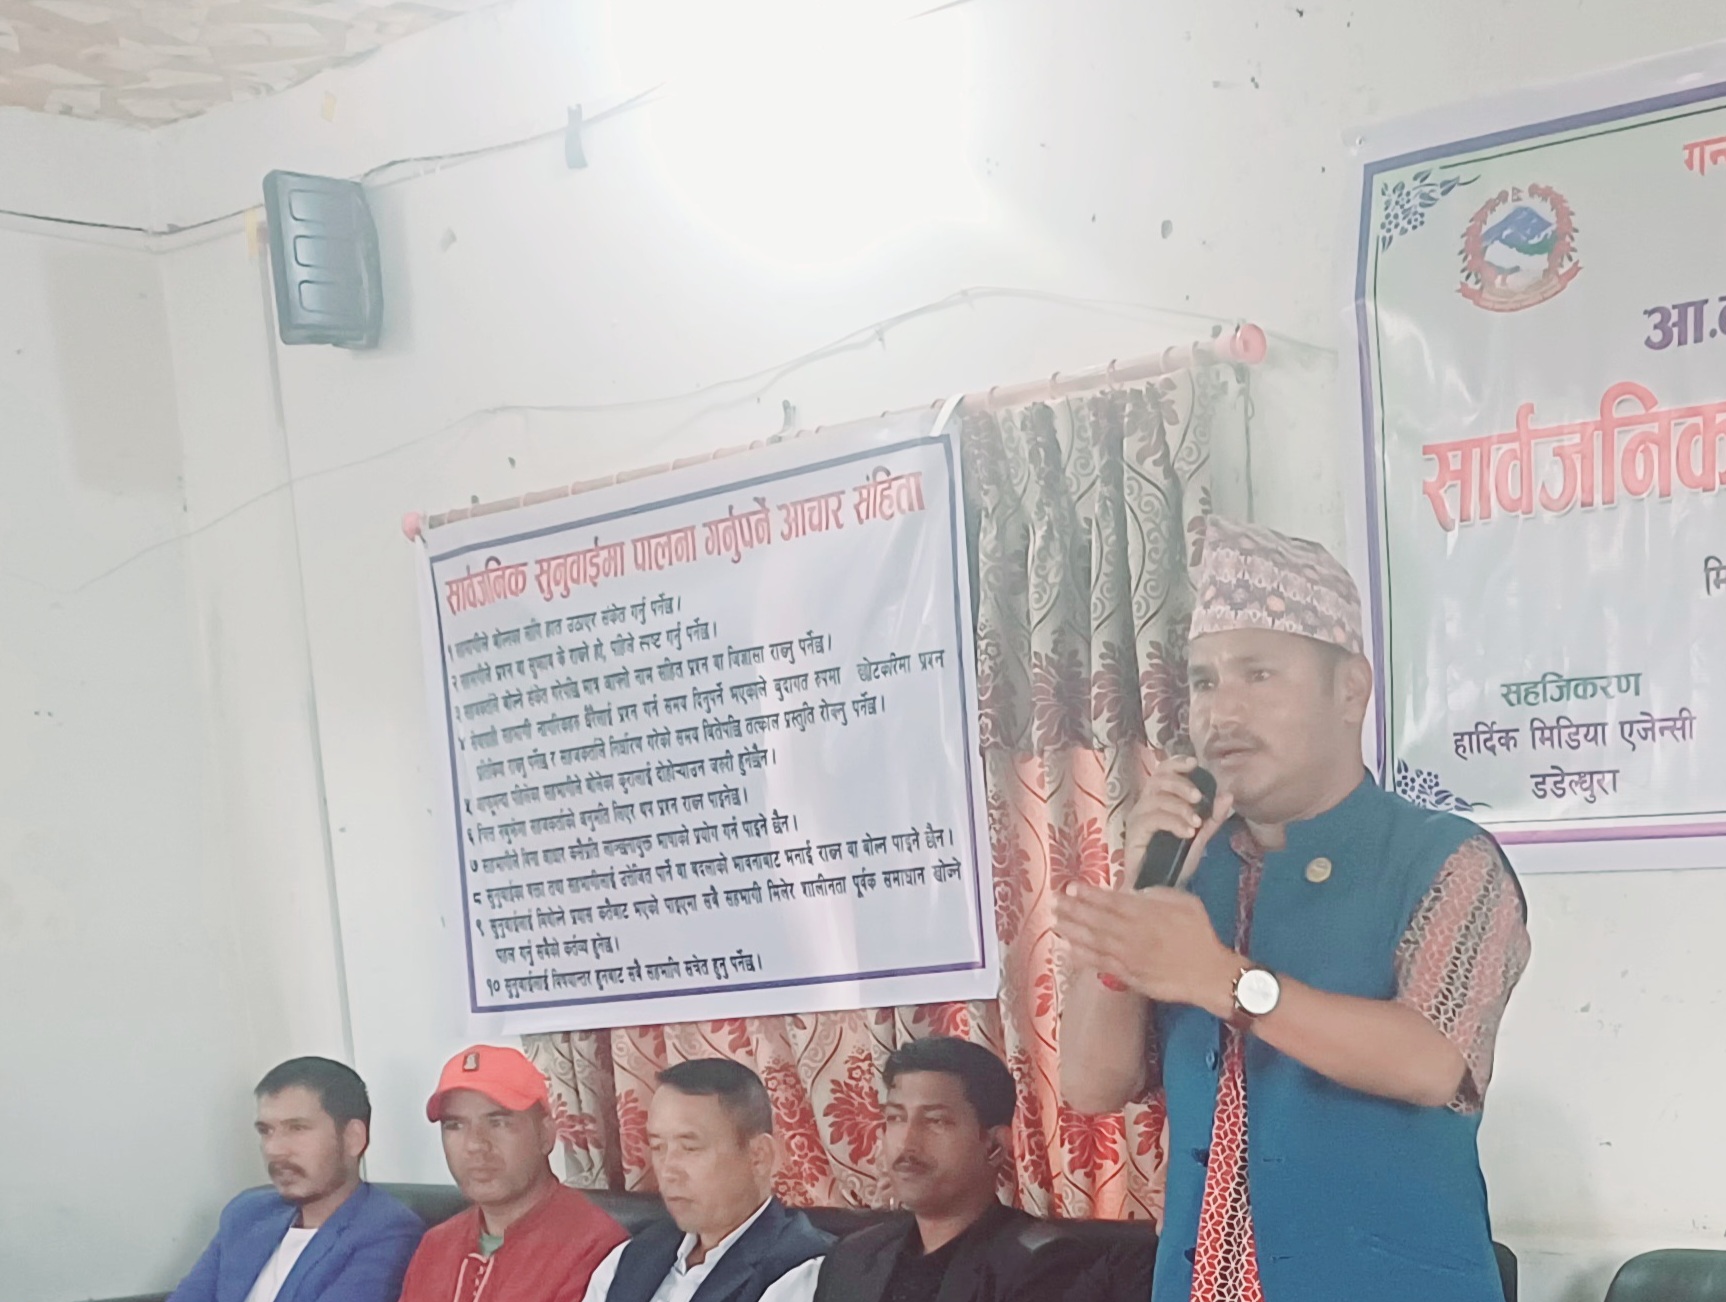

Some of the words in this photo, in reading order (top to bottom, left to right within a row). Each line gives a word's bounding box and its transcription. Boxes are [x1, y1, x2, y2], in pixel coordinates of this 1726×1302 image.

[631, 525, 696, 571] पालना
[777, 490, 845, 540] आचार
[852, 465, 924, 524] संहिता
[1500, 672, 1642, 707] सहजिकरण
[1530, 715, 1608, 750] मिडिया
[1618, 707, 1696, 752] एजेन्सी
